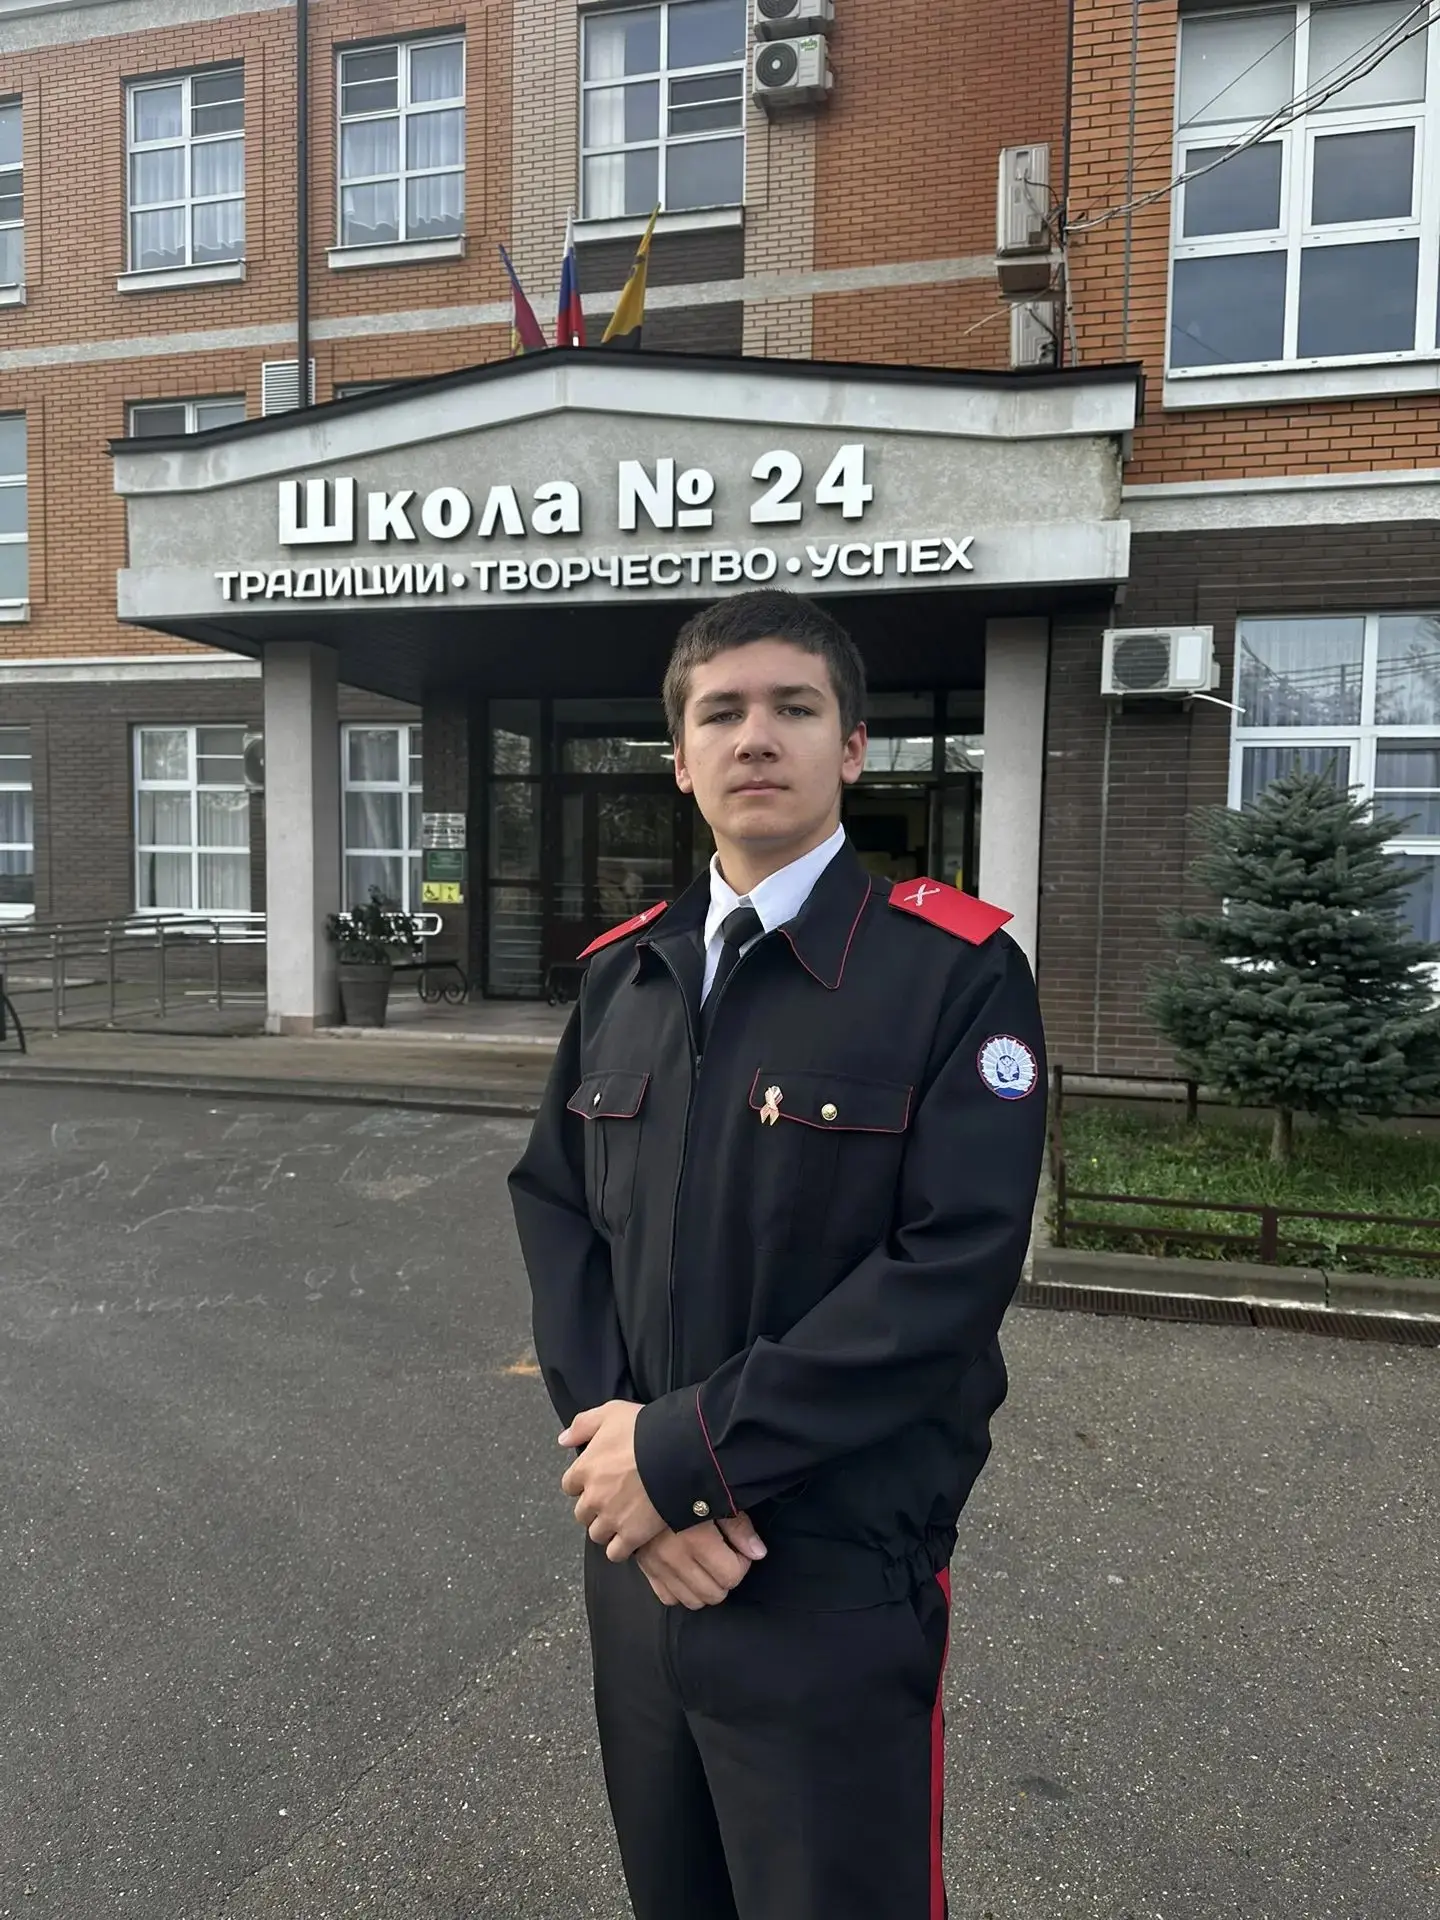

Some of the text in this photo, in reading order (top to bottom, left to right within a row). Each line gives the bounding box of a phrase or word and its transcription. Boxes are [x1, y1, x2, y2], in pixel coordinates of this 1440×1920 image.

[278, 443, 873, 546] Школа № 24
[214, 535, 976, 600] ТРАДИЦИИ ТВОРЧЕСТВО УСПЕХ
